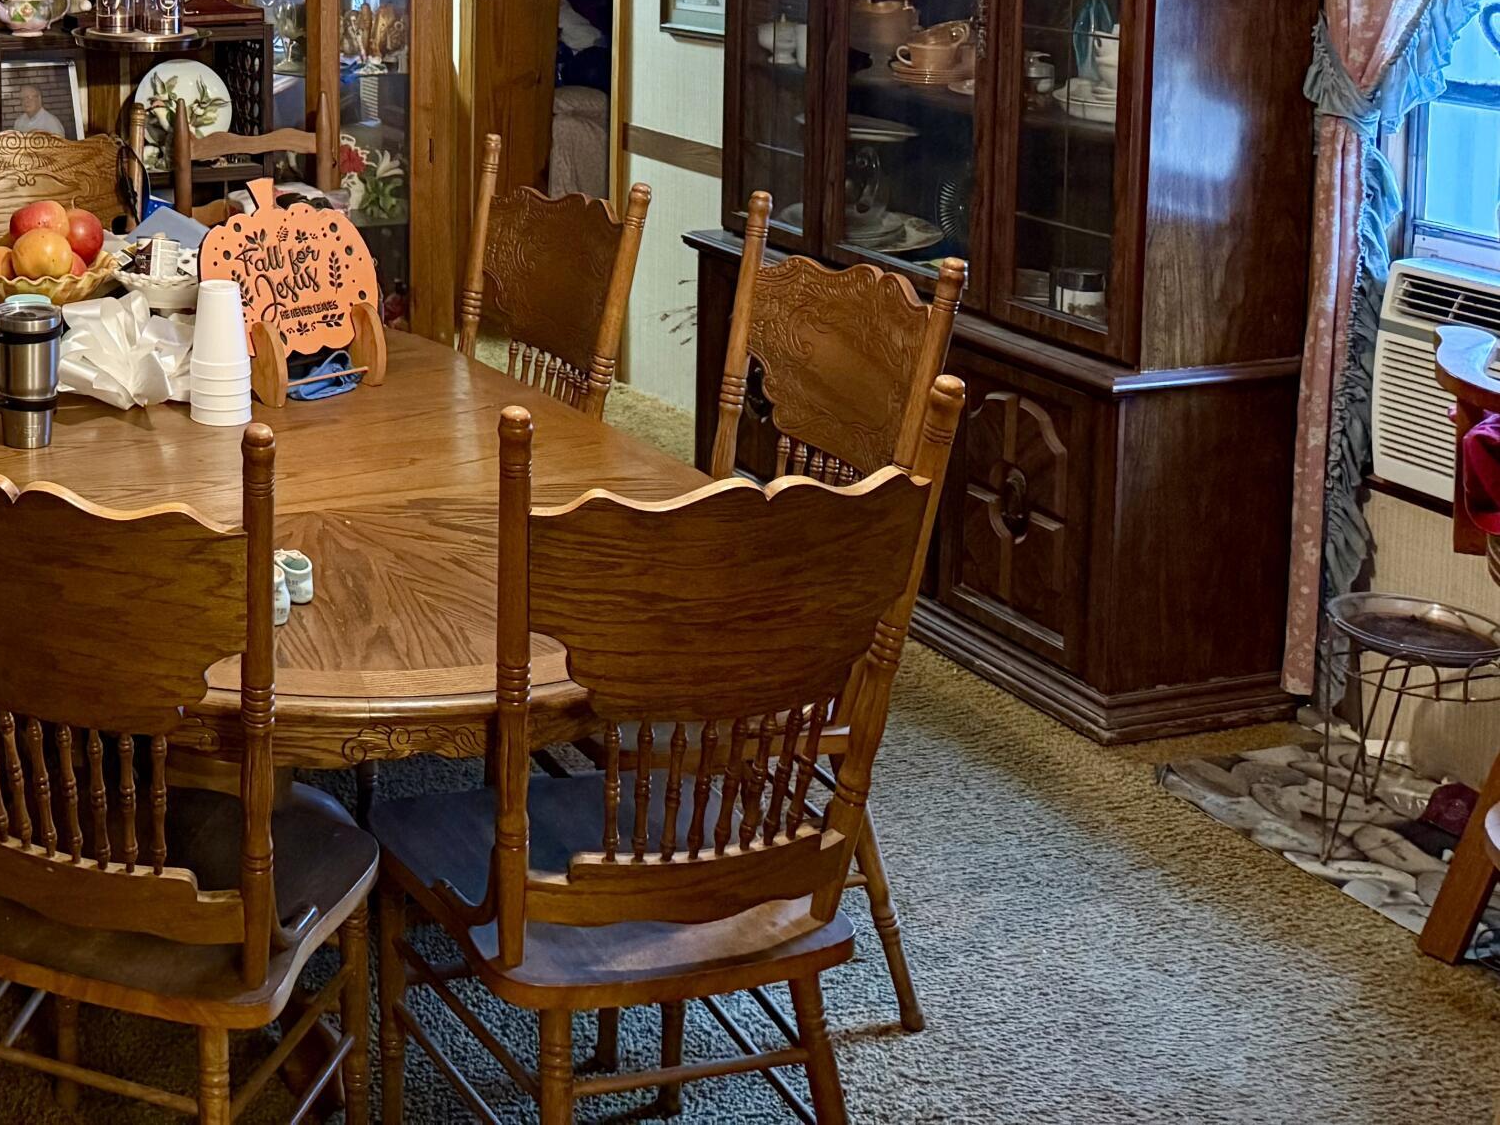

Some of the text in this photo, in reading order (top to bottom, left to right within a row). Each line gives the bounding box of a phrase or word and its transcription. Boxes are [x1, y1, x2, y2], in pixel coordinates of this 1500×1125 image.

[234, 244, 320, 276] Fall for
[255, 265, 321, 323] Jesus
[280, 309, 291, 320] HE
